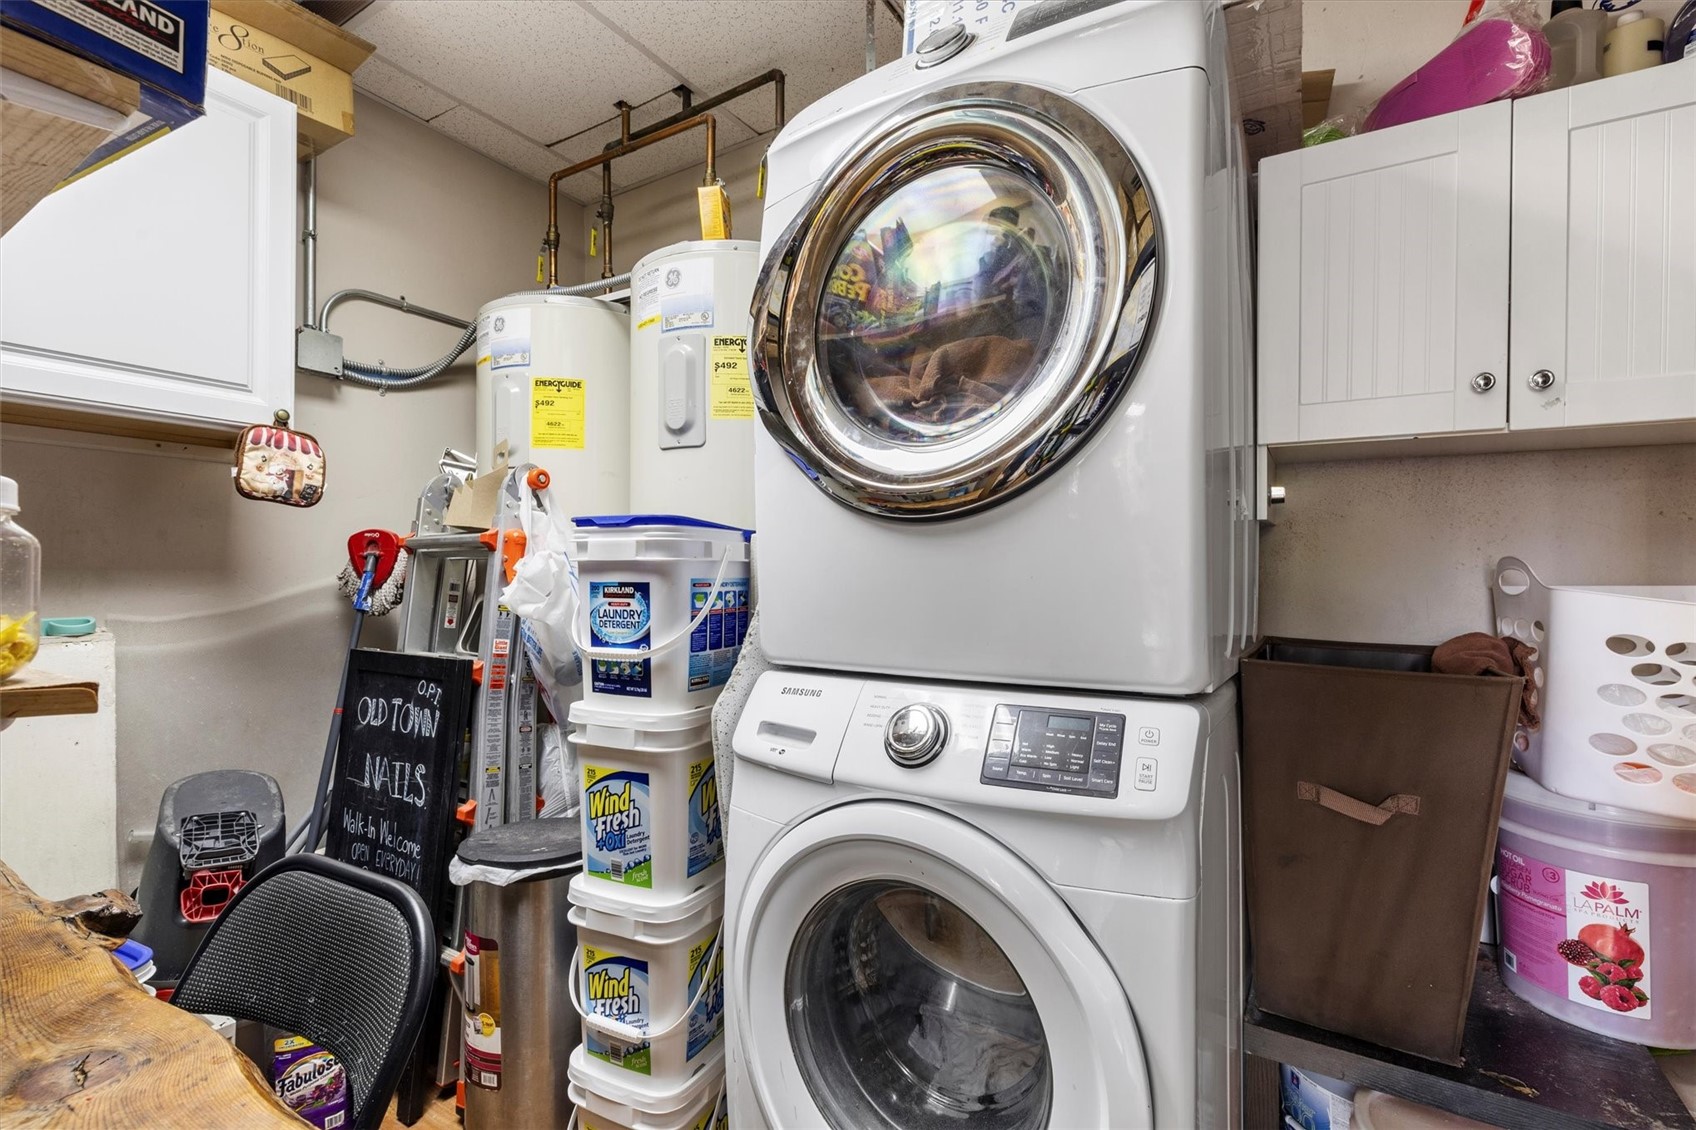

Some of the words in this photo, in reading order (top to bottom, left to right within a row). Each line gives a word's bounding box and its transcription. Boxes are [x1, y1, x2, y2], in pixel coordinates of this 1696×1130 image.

[534, 379, 583, 390] ENERGYGUIDE
[598, 608, 642, 620] LAUNDRY
[599, 620, 641, 629] DETERGENT
[781, 687, 823, 698] SAMSUNG
[357, 696, 388, 726] OLD
[391, 698, 441, 739] TOWN
[691, 763, 702, 773] 215
[589, 781, 631, 820] Wind
[594, 800, 641, 841] Fresh
[343, 807, 376, 840] Walk-In
[379, 817, 421, 859] Welcome
[627, 831, 645, 840] Laundry
[627, 835, 650, 845] Detergent
[351, 842, 369, 861] OPEN
[691, 945, 702, 957] 215
[588, 967, 630, 1000] Wind
[594, 986, 640, 1017] Fresh
